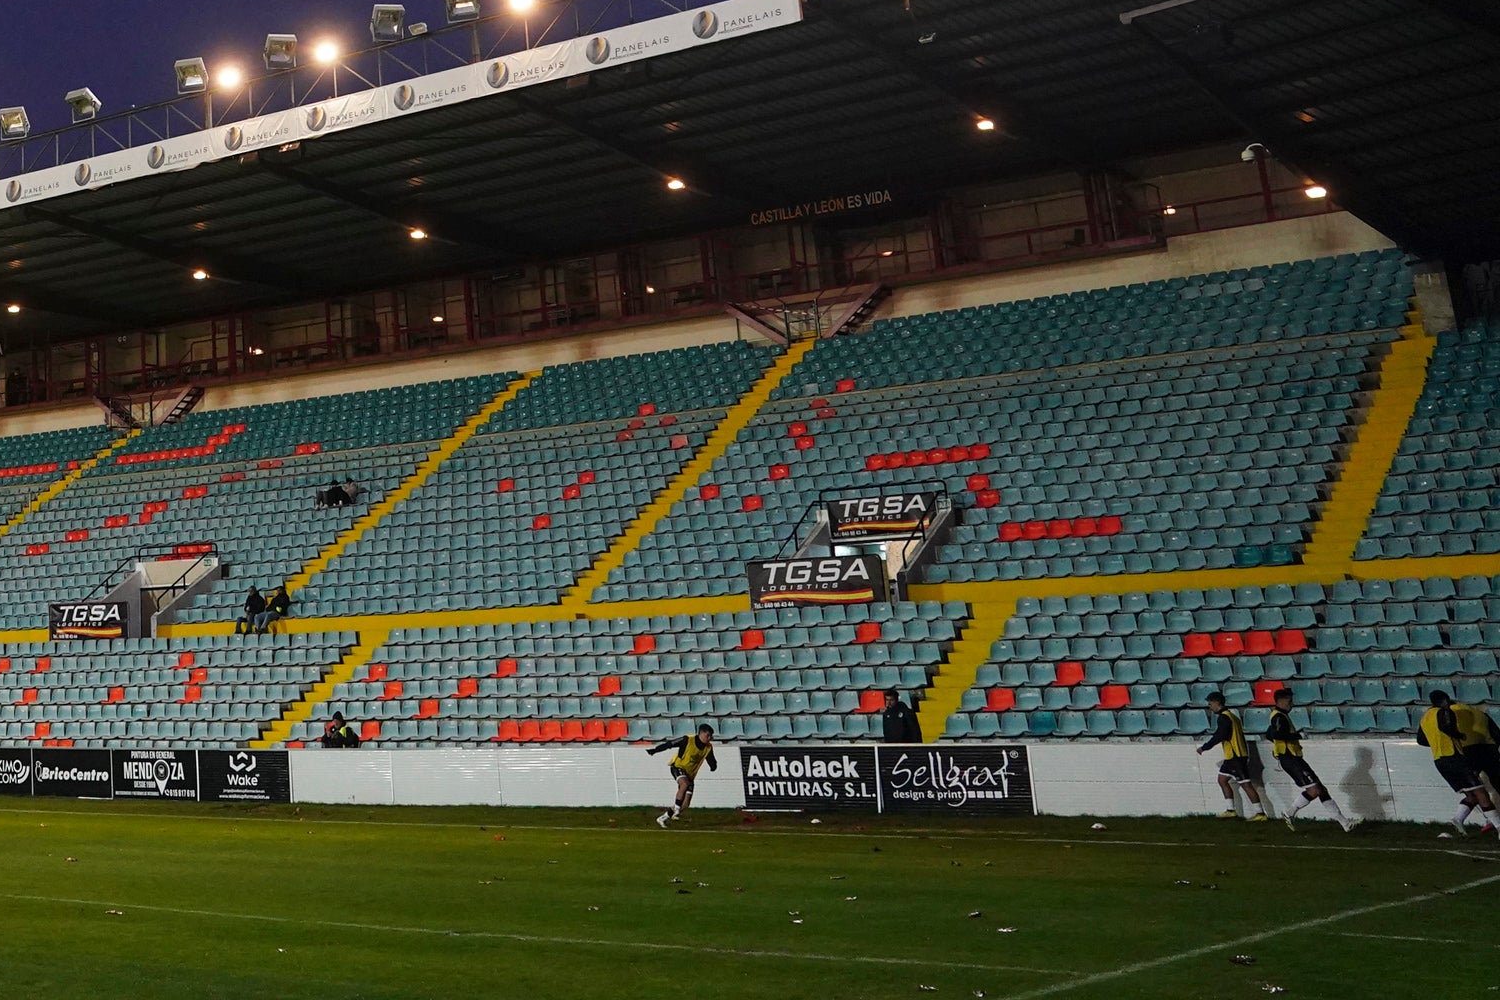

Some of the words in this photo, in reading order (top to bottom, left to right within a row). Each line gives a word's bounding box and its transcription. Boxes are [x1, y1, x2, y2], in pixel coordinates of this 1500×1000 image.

[723, 8, 782, 31] PANELAIS
[615, 36, 669, 56] PANELAIS
[513, 61, 565, 81] PANELAIS
[418, 84, 467, 103] PANELAIS
[330, 106, 375, 125] PANELAIS
[246, 128, 289, 145] PANELAIS
[168, 147, 208, 162] PANELAIS
[94, 165, 132, 180] PANELAIS
[24, 182, 60, 196] PANELAIS
[751, 206, 803, 225] CASTILLA
[804, 203, 811, 215] Y
[847, 196, 862, 209] ES
[864, 190, 892, 206] VIDA
[839, 494, 927, 517] TGSA
[838, 514, 902, 523] LOGISTICS
[763, 558, 869, 585] TGSA
[761, 582, 839, 592] LOGISTICS
[59, 604, 121, 622] TGSA
[131, 750, 149, 759] PINTURA
[150, 751, 155, 759] EN
[156, 751, 176, 759] GENERAL
[41, 766, 109, 781] BricoCentro
[747, 755, 860, 778] Autolack
[227, 774, 259, 786] Wake
[748, 780, 839, 800] PINTURAS,
[845, 783, 876, 798] S.L.
[893, 789, 925, 800] design
[927, 789, 935, 799] &
[937, 789, 962, 801] print
